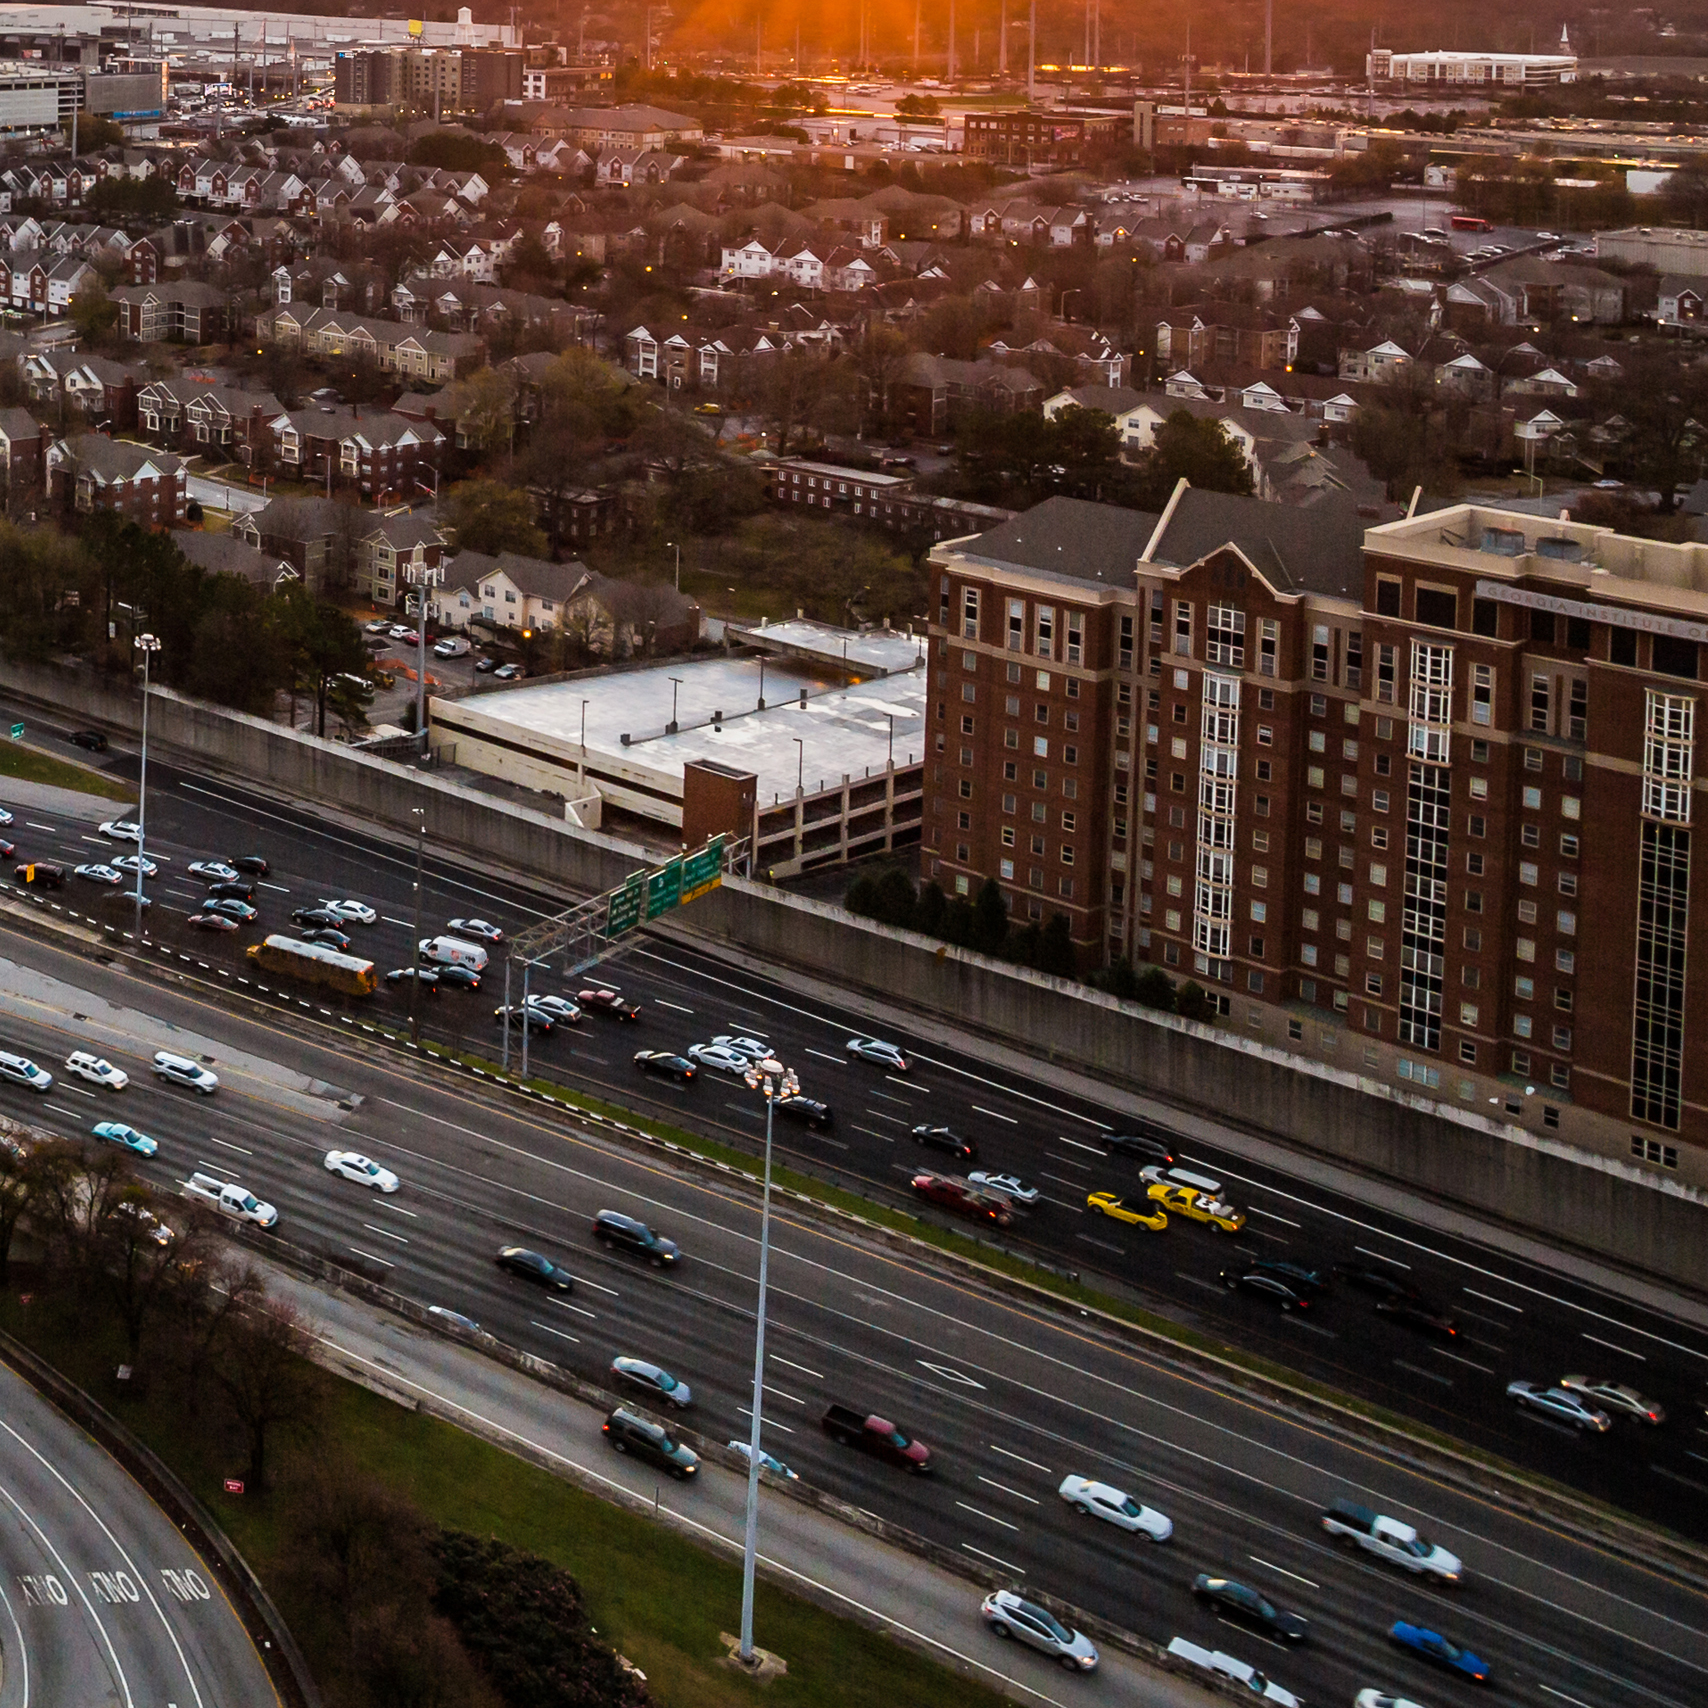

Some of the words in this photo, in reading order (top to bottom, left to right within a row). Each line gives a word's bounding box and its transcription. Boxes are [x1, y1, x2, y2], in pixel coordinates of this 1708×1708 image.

[1486, 585, 1568, 612] GEORGIA
[1578, 606, 1676, 634] INSTITUTE
[16, 1574, 68, 1607] ONLY
[86, 1571, 139, 1604] ONLY
[160, 1568, 211, 1601] ONLY
